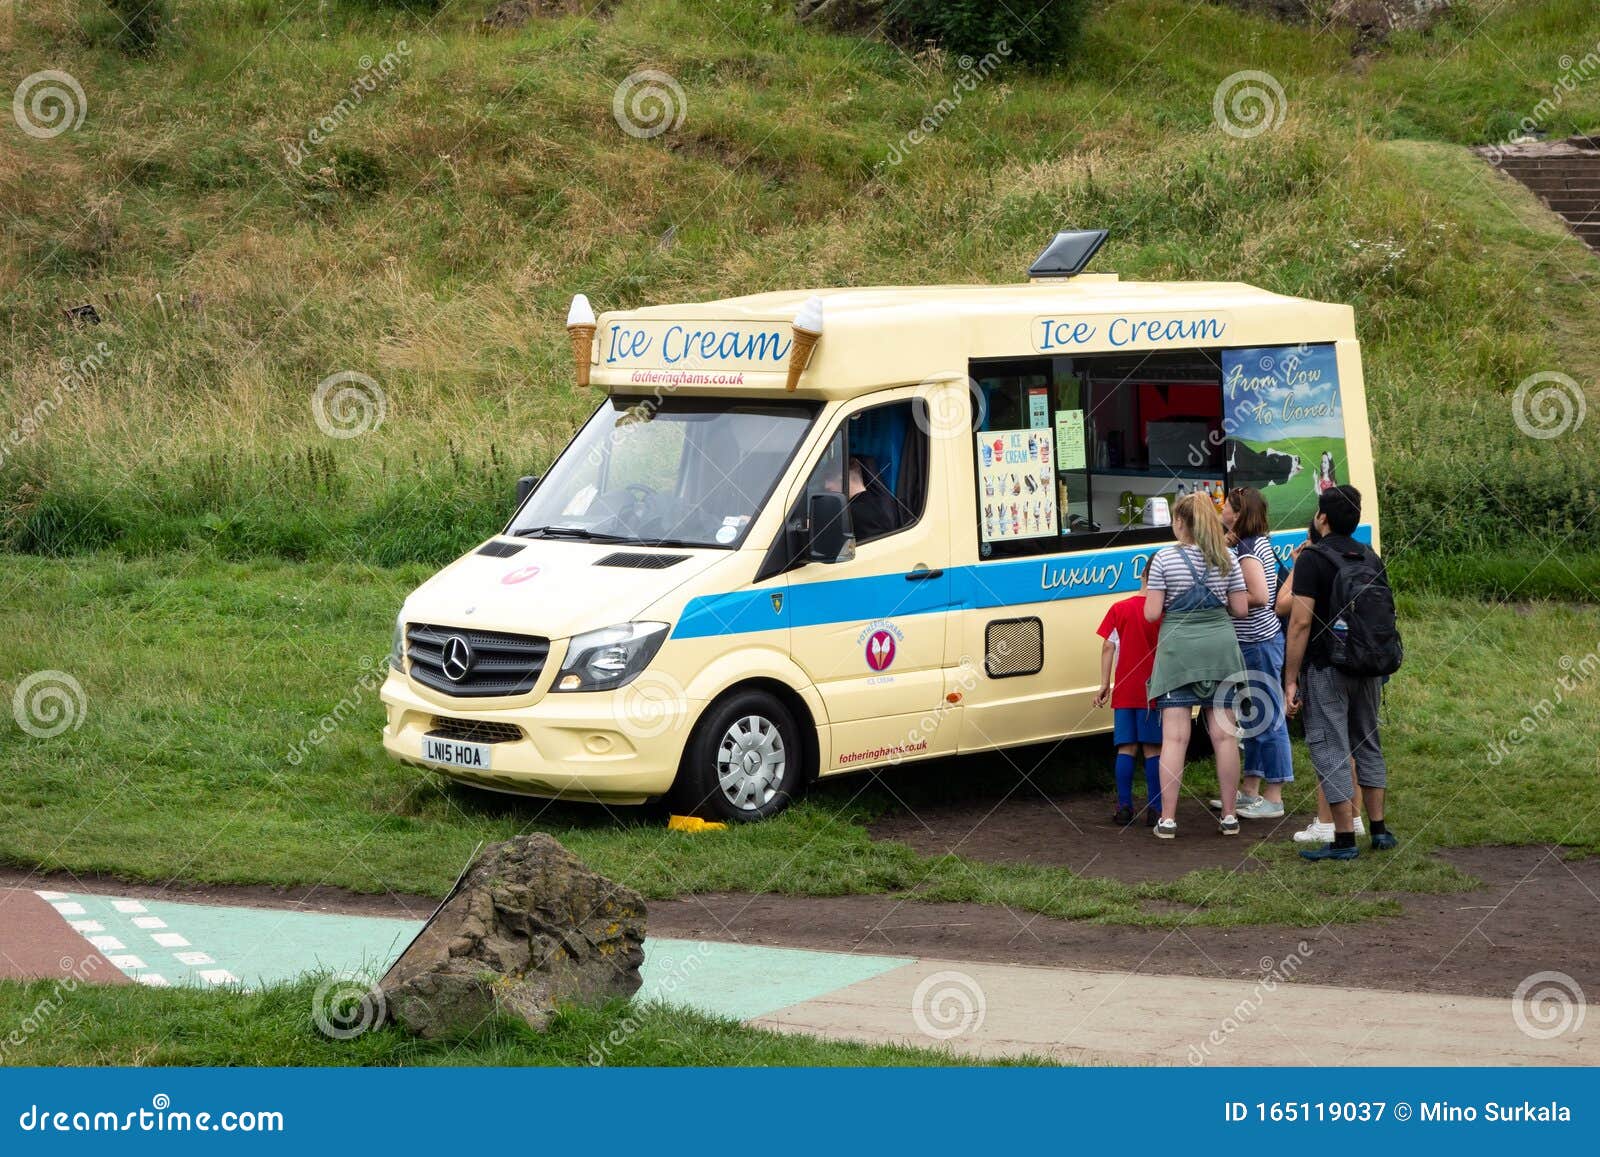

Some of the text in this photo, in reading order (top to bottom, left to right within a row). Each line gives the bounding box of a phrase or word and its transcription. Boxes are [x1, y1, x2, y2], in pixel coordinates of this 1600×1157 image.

[606, 325, 792, 364] Ice Cream
[1039, 316, 1226, 350] Ice Cream
[631, 370, 744, 388] fotheringhams.co.uk
[1228, 356, 1321, 400] From Cow
[1251, 390, 1337, 425] to Cone!
[1041, 561, 1124, 590] Luxury
[427, 740, 452, 762] LN15
[839, 741, 928, 764] fotheringhams.co.uk
